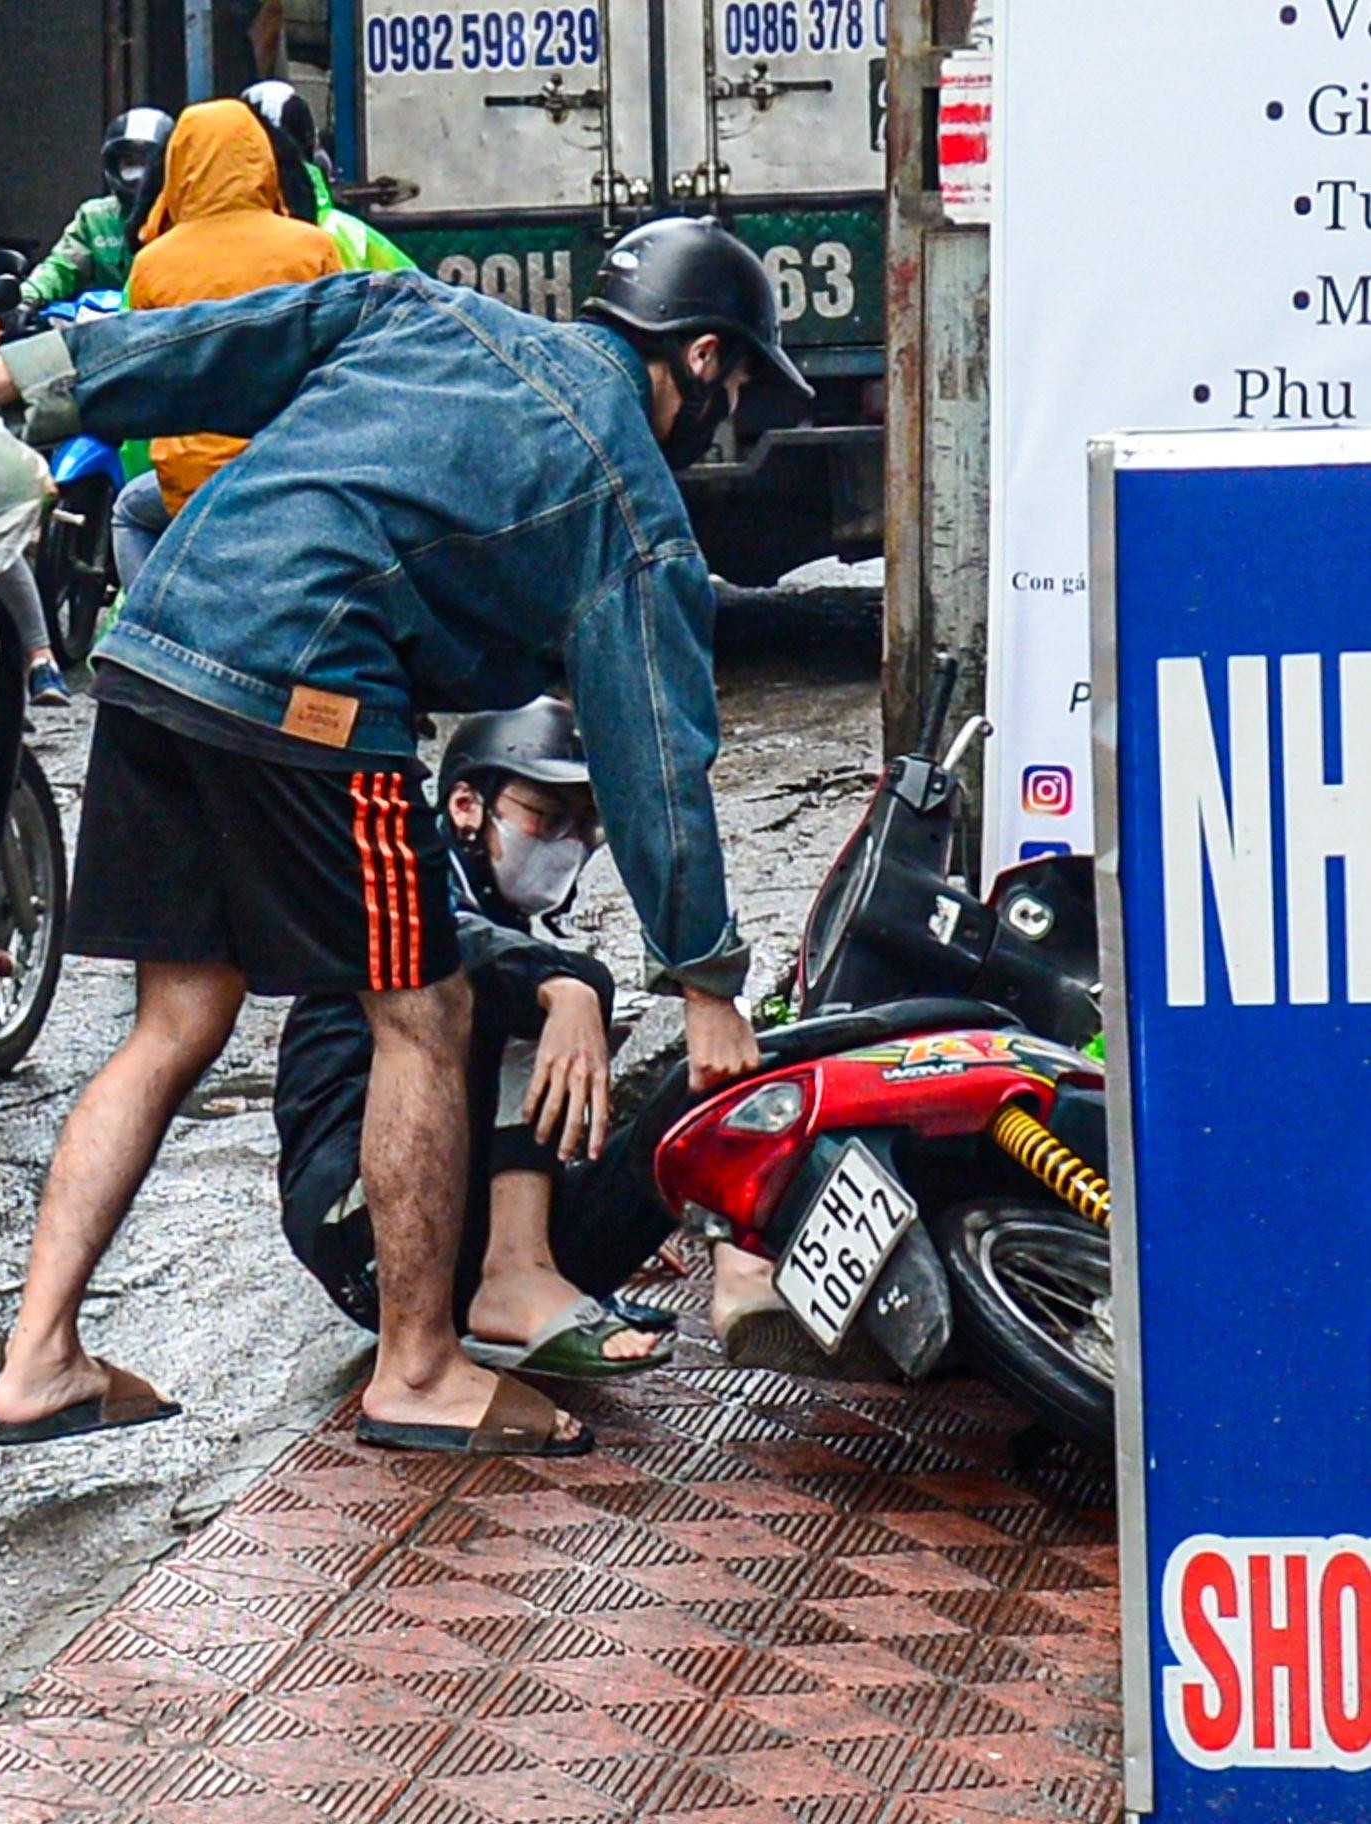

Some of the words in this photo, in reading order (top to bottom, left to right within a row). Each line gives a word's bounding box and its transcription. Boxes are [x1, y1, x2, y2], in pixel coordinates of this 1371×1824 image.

[368, 15, 454, 73] 0982
[461, 12, 526, 68] 598
[534, 8, 599, 65] 239
[726, 2, 798, 55] 0986
[809, 0, 863, 50] 378
[1326, 0, 1371, 40] V
[764, 241, 854, 321] 63
[1232, 367, 1357, 420] Phu
[1012, 571, 1055, 591] Con
[1157, 651, 1371, 1006] NH
[791, 1169, 864, 1285] 15-H1
[810, 1187, 906, 1332] 106.72
[1181, 1551, 1371, 1753] SHO
